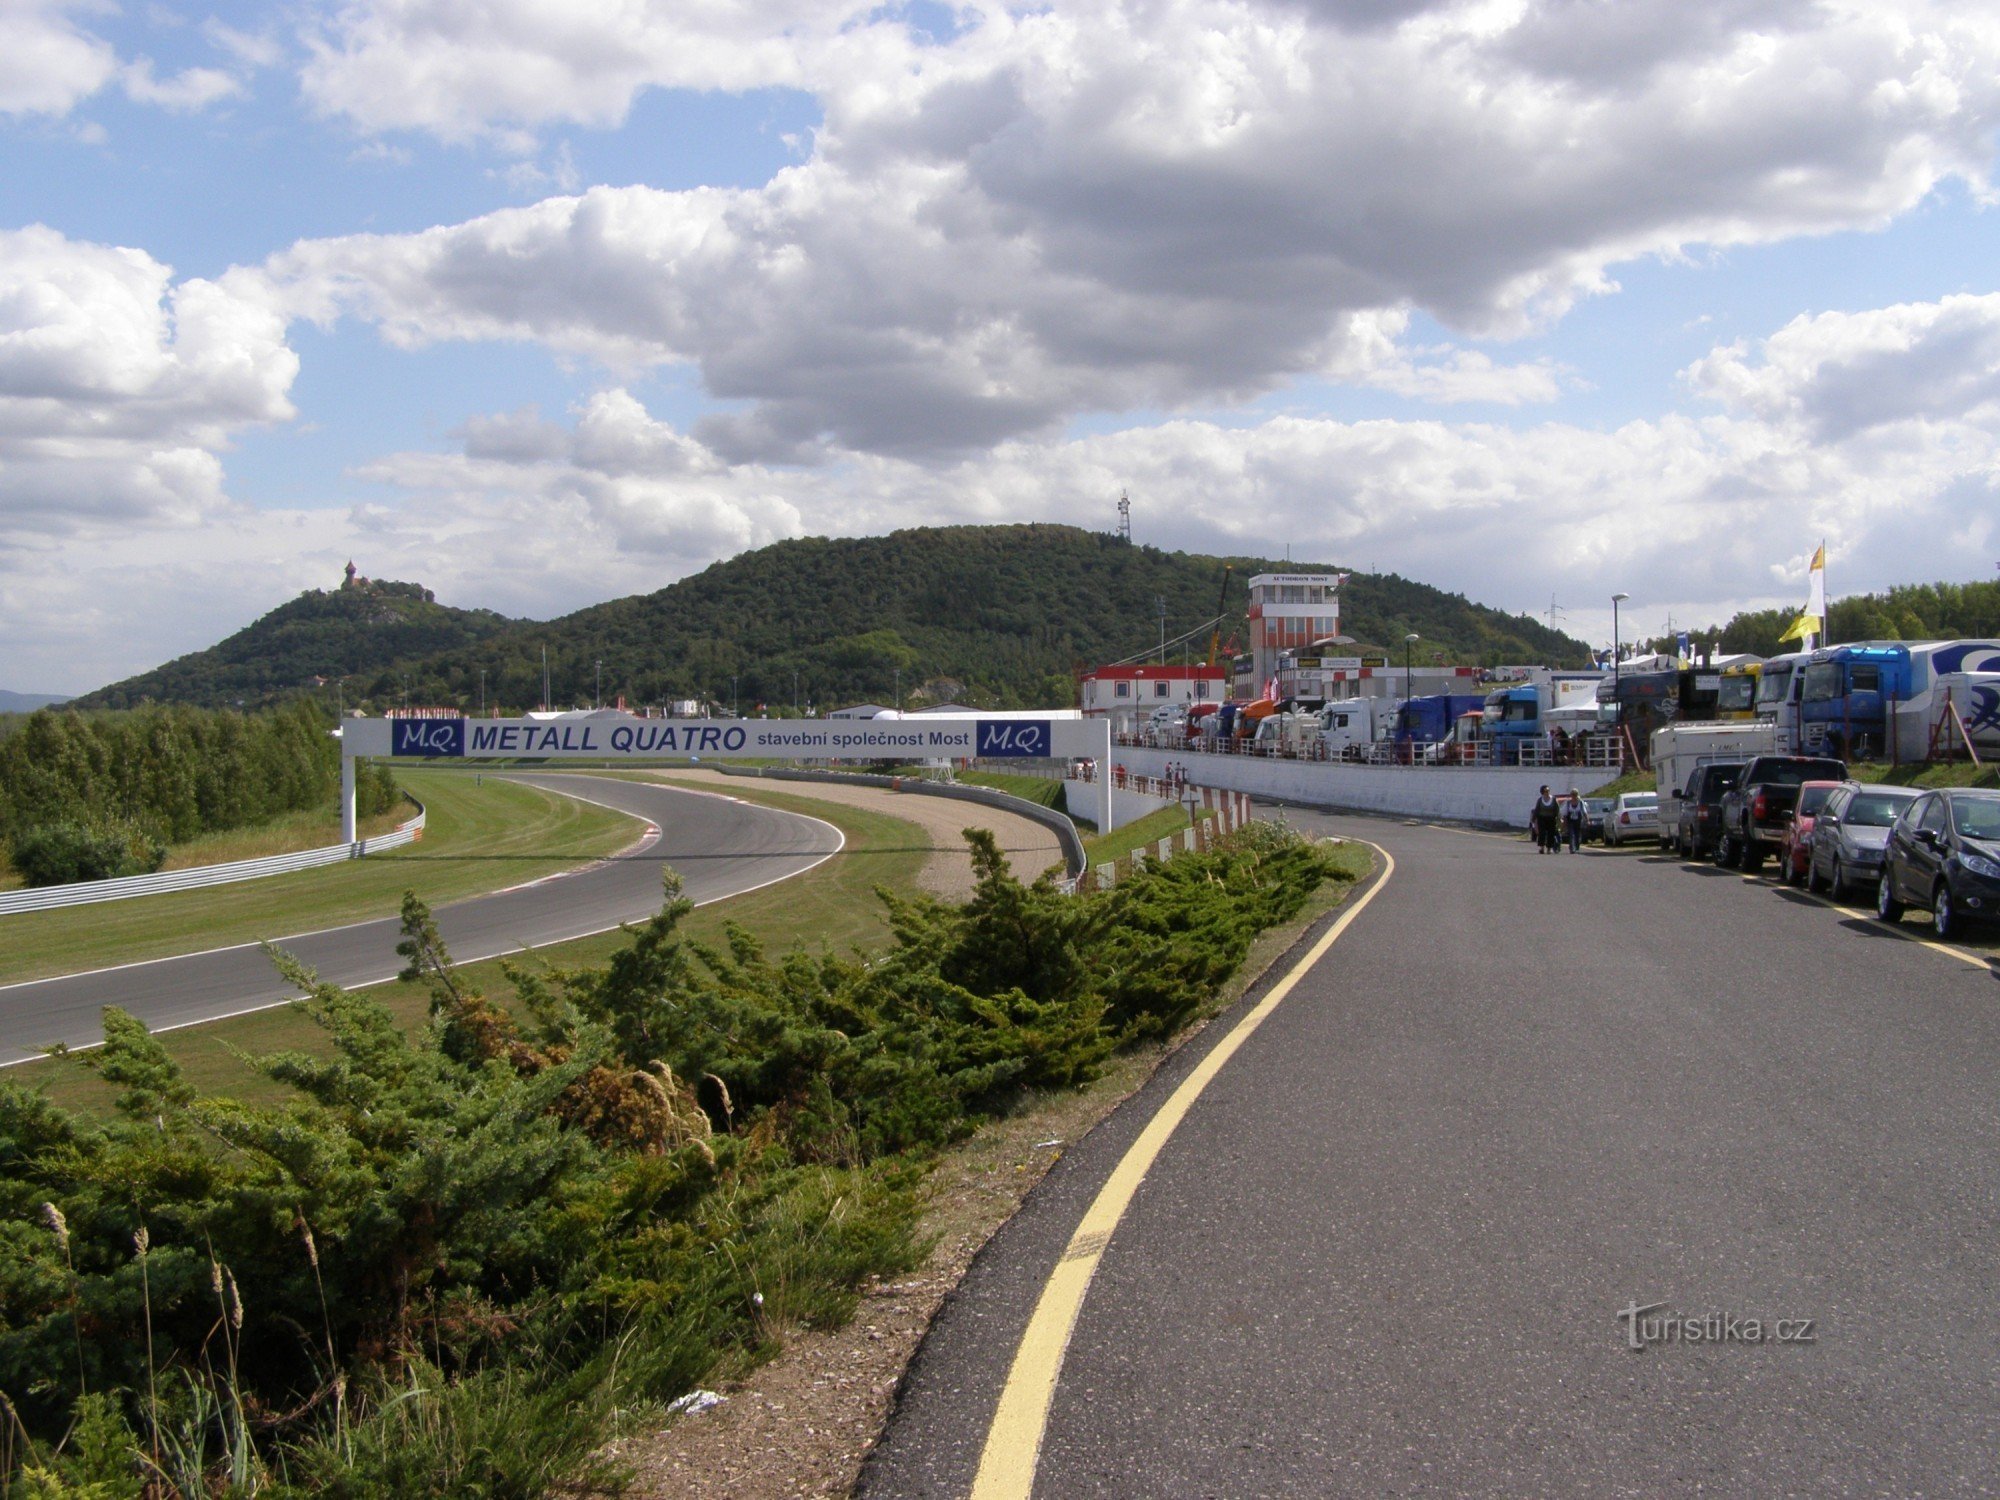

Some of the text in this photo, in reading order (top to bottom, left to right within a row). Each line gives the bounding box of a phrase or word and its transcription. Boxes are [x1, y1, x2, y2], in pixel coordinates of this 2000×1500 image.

[401, 722, 1043, 753] M.Q. METALL QUATRO stavební společnost Most M.Q.
